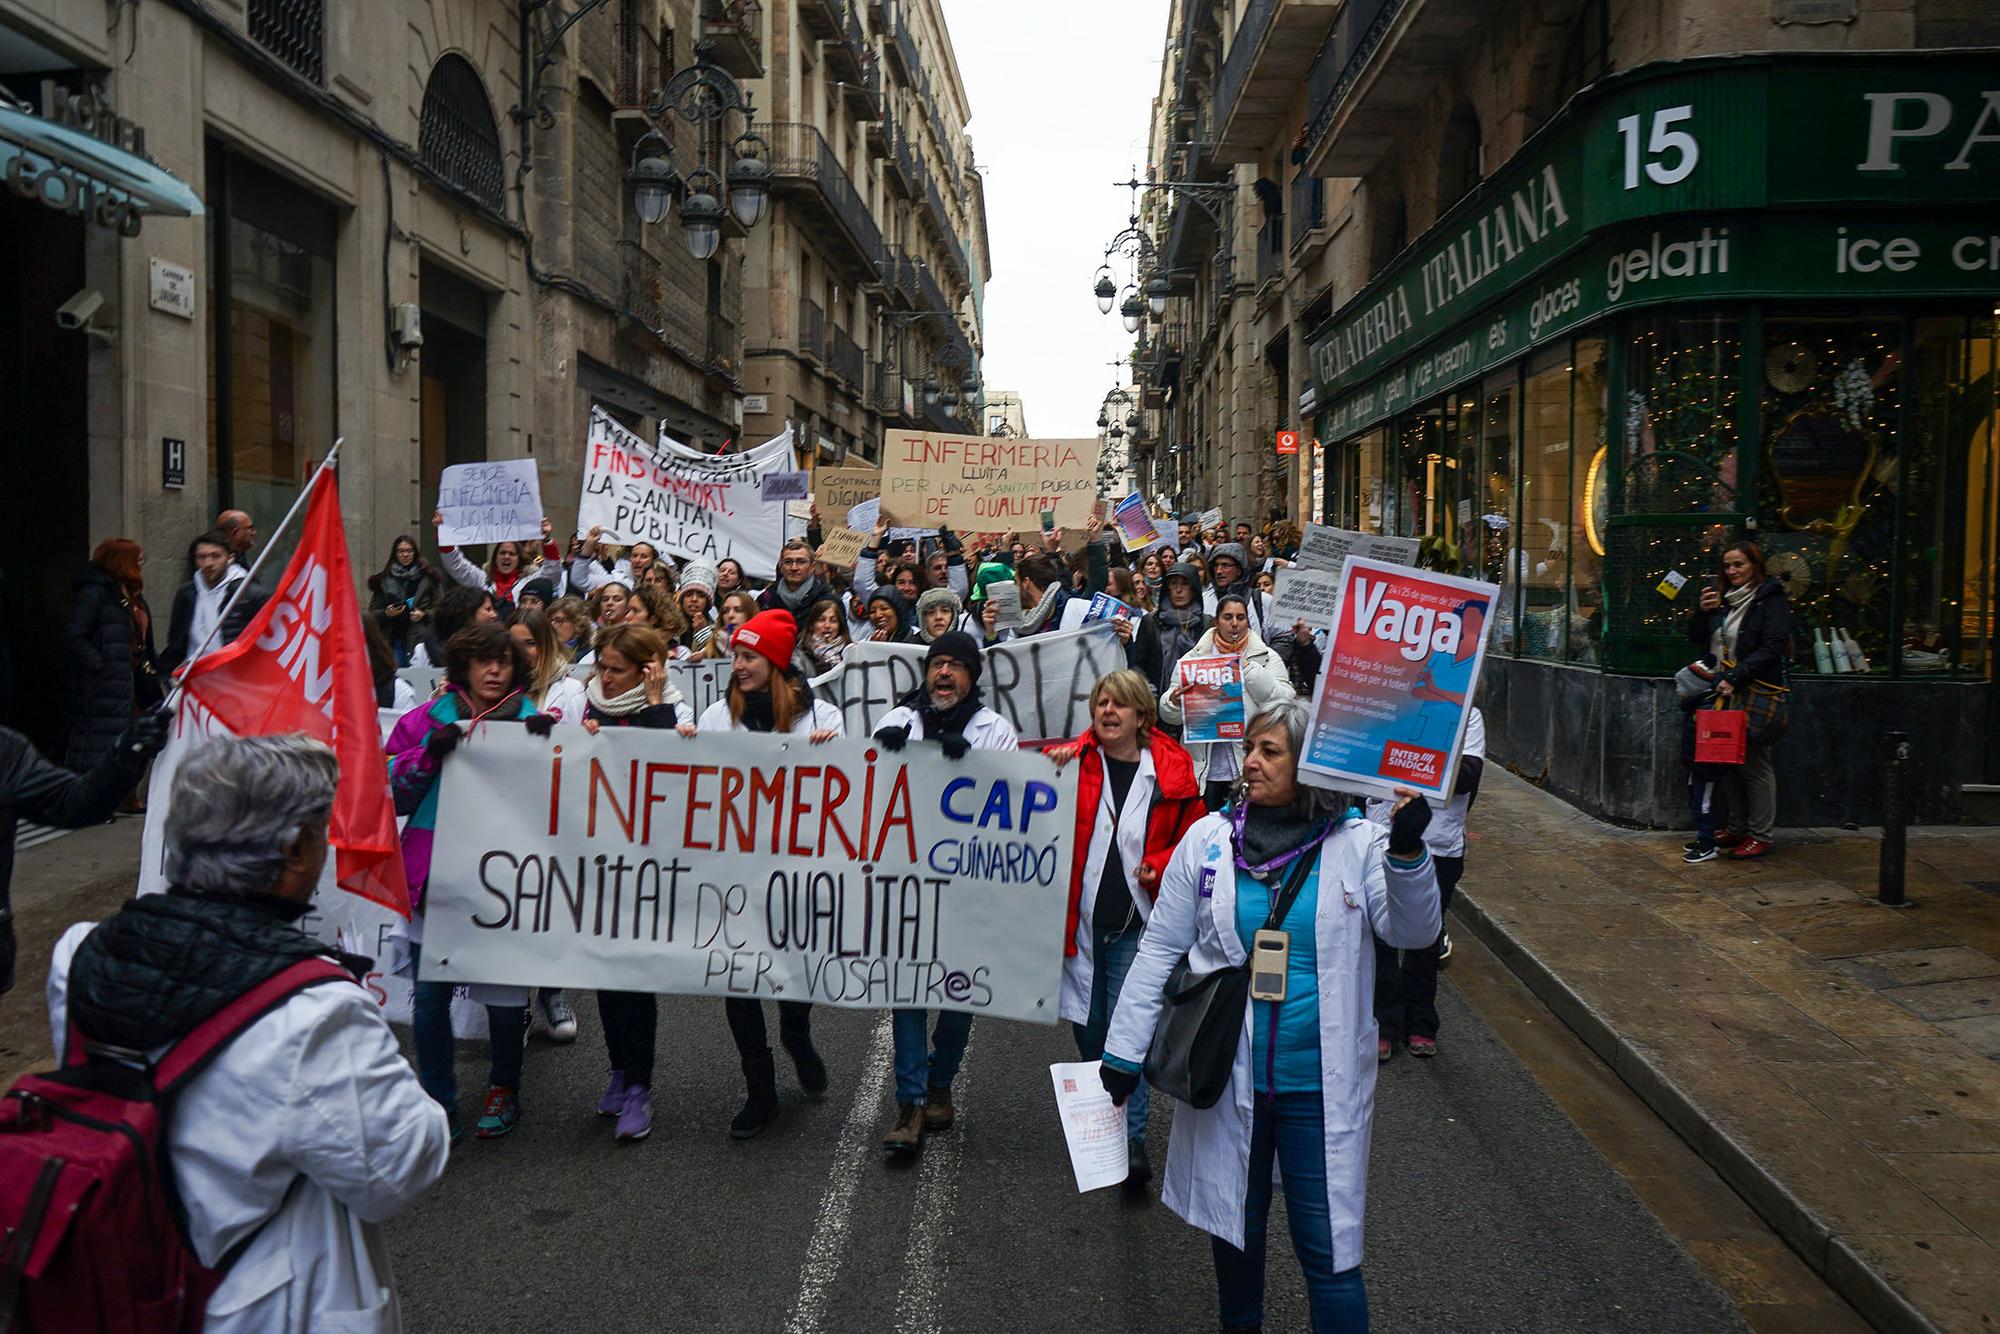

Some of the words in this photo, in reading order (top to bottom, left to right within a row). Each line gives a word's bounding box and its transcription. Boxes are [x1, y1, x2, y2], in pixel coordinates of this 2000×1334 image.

[1617, 104, 1699, 190] 15
[1607, 227, 1729, 302] gelati
[1836, 226, 1921, 273] ice
[1318, 285, 1413, 385] GELATERIA
[1421, 164, 1569, 316] ITALIANA
[1433, 340, 1471, 379] cream
[1487, 315, 1508, 350] eis
[1528, 278, 1581, 341] glaces
[591, 443, 647, 479] FINS
[902, 438, 1083, 468] INFERMERIA
[586, 474, 615, 498] LA
[891, 477, 930, 494] PER
[941, 482, 975, 496] UNA
[984, 481, 1037, 496] SANITAT
[1041, 476, 1094, 493] PÚBLICA
[961, 466, 1008, 481] LLUITA
[926, 498, 951, 516] DE
[974, 496, 1064, 518] QUALITAT
[1354, 576, 1462, 661] Vaga
[1183, 663, 1234, 690] Vaga
[1333, 666, 1349, 679] Una
[1368, 674, 1382, 687] per
[1335, 652, 1351, 665] Una
[1372, 660, 1382, 671] de
[1388, 757, 1436, 774] SINDICAL
[1390, 747, 1420, 761] INTER
[548, 745, 918, 865] INFERMERIA
[939, 775, 1058, 835] CAP
[471, 849, 692, 944] SANITAT
[764, 862, 951, 962] QUALITAT
[704, 949, 778, 994] PER
[803, 950, 994, 1007] VOSALTR@S
